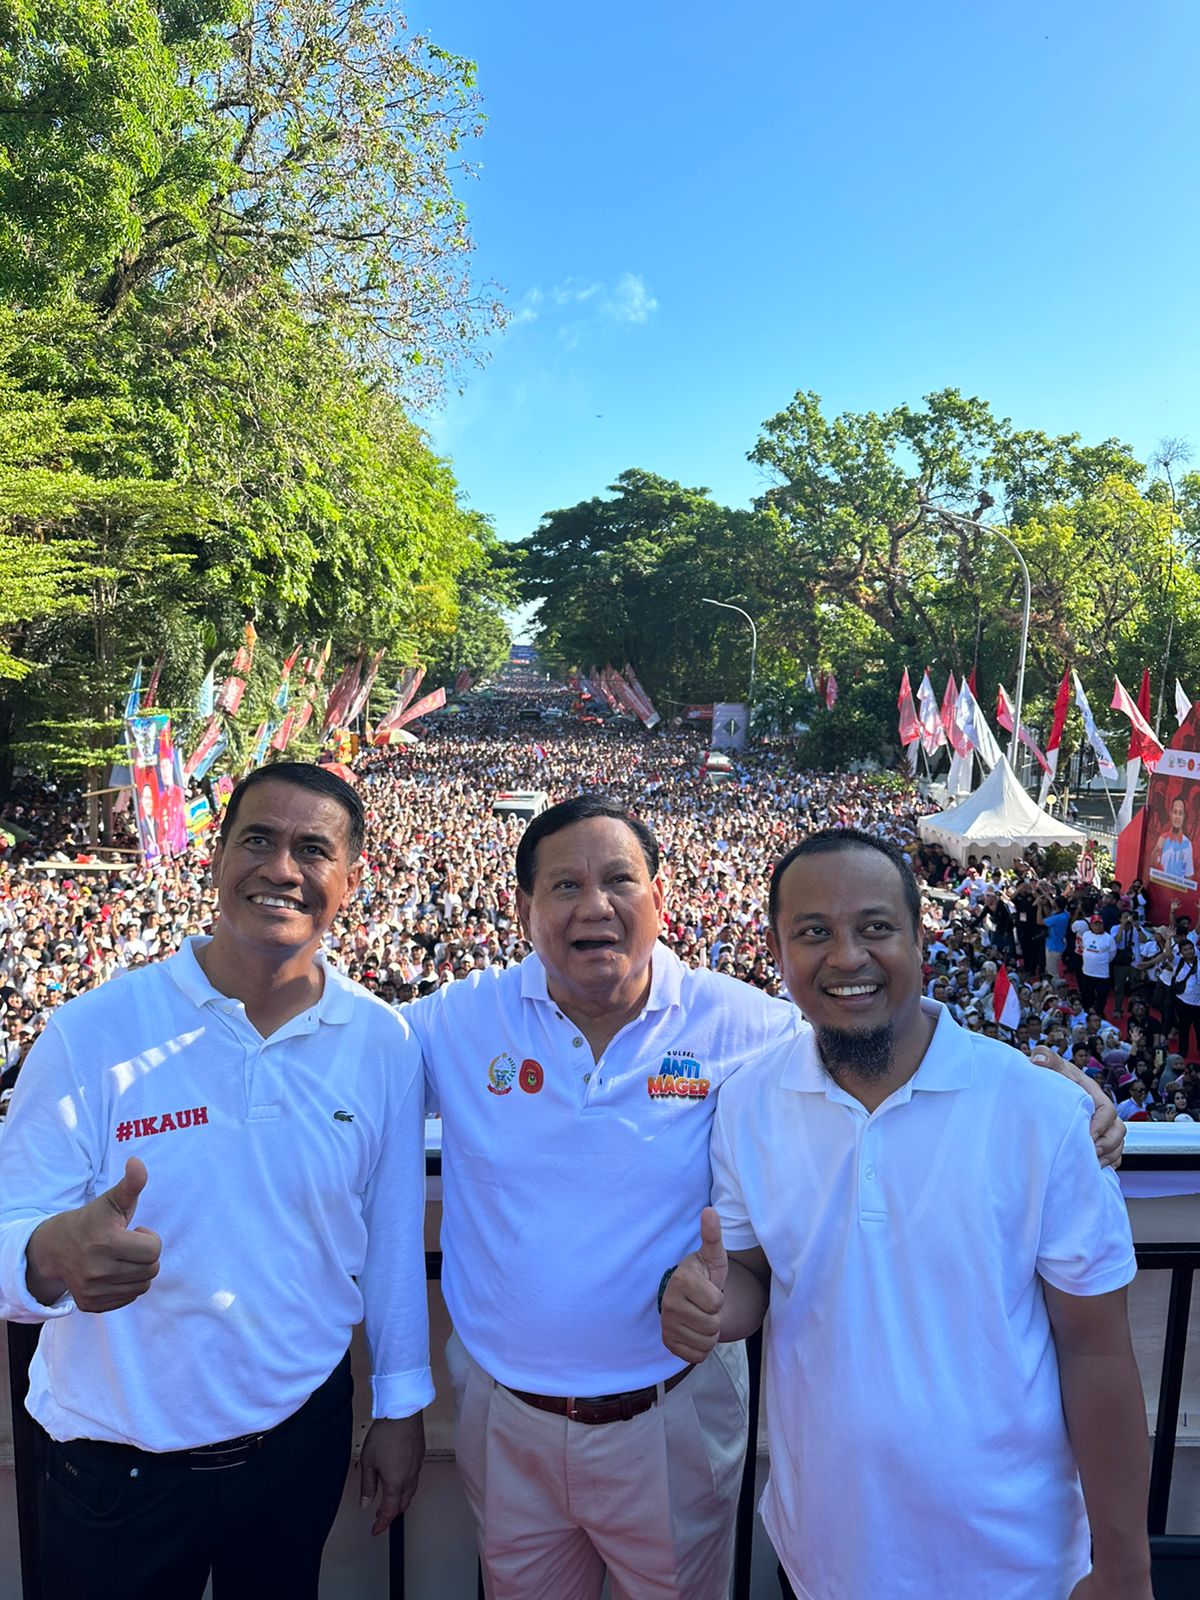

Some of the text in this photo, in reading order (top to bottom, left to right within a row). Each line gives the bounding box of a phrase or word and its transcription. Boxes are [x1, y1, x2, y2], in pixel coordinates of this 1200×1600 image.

[1084, 858, 1092, 877] P
[659, 1057, 701, 1079] ANTI
[647, 1075, 710, 1098] MAGER
[116, 1106, 209, 1142] #IKAUH
